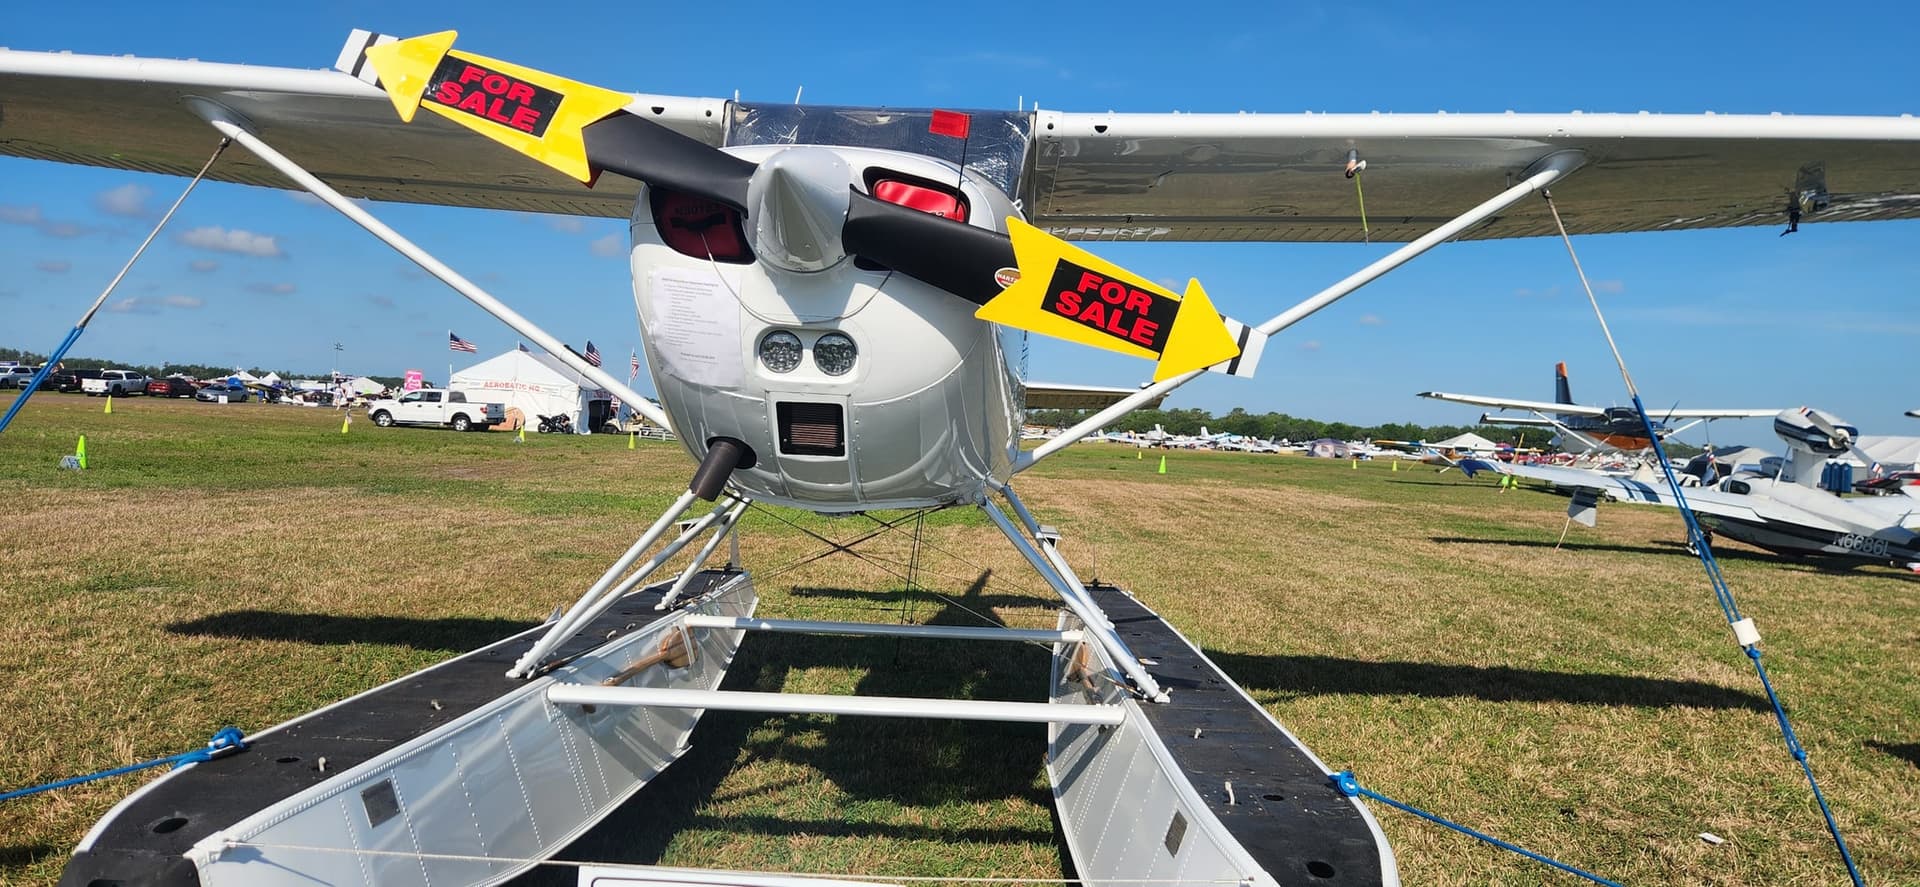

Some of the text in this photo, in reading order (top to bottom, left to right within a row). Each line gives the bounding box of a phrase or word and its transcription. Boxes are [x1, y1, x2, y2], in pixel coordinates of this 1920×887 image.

[458, 65, 536, 105] FOR
[435, 80, 541, 133] SALE
[1077, 271, 1153, 316] FOR
[1055, 290, 1159, 346] SALE
[484, 381, 527, 390] AEROBATIC
[1832, 533, 1892, 557] N6686L
